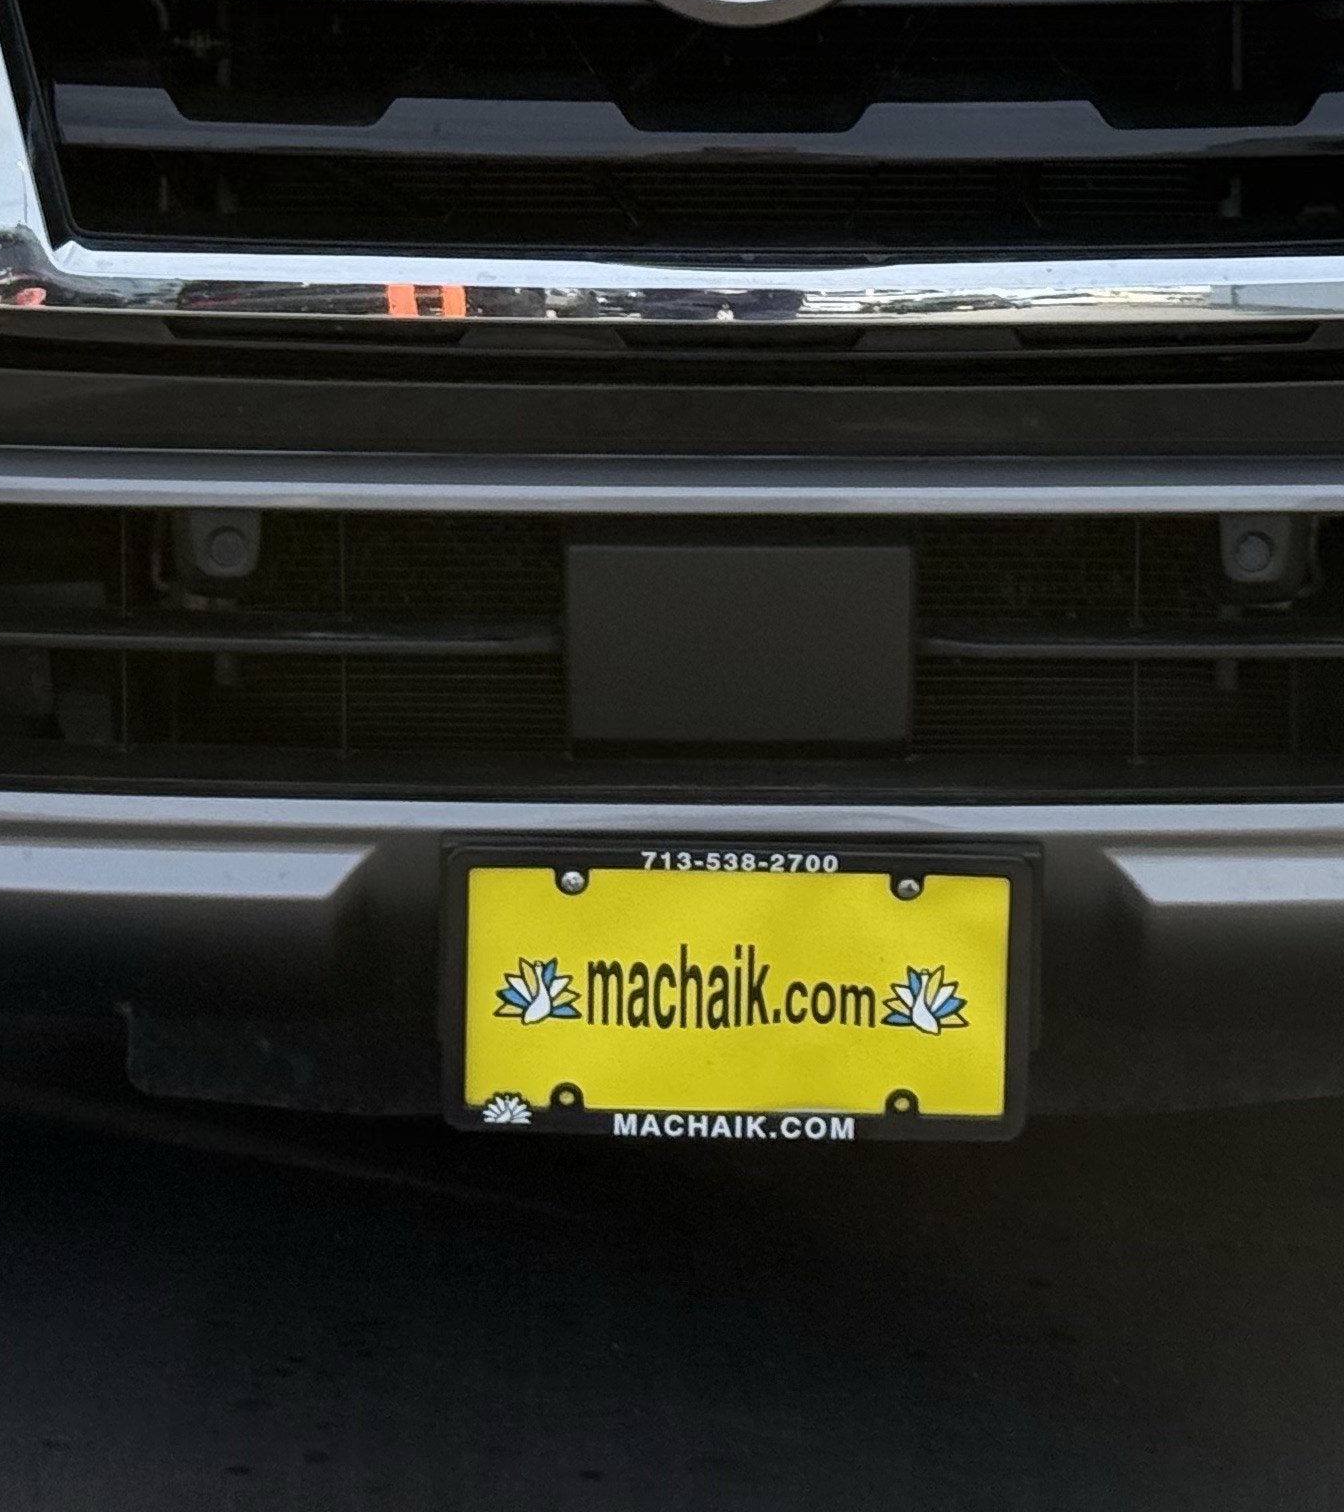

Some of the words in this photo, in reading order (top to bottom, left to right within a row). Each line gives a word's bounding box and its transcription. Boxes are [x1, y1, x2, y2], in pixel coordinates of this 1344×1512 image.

[641, 851, 838, 873] 713-538-2700
[587, 944, 876, 1030] machaik.com
[613, 1113, 856, 1140] MACHAIK.COM
